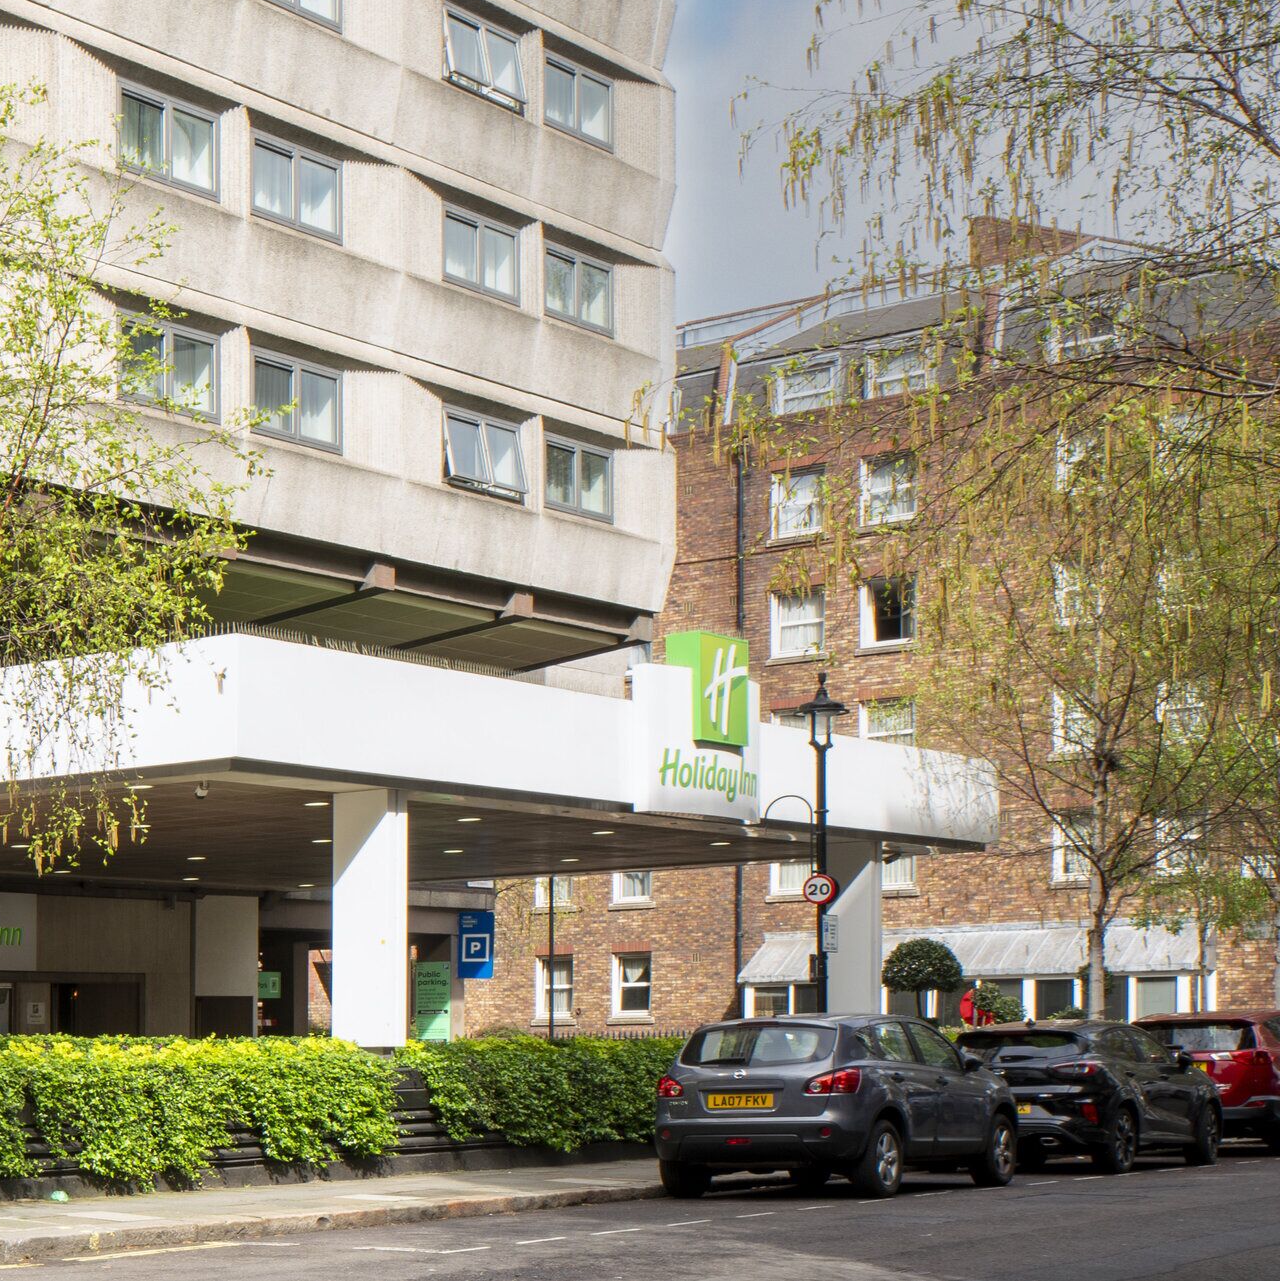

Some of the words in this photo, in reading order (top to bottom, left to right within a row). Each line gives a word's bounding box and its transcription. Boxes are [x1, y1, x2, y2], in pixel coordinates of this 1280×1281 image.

[659, 748, 738, 802] Holiday
[739, 757, 757, 798] Inn
[808, 883, 830, 896] 20
[470, 941, 481, 954] P
[417, 979, 449, 987] parking.
[713, 1095, 742, 1106] LA07
[745, 1095, 767, 1106] FKV
